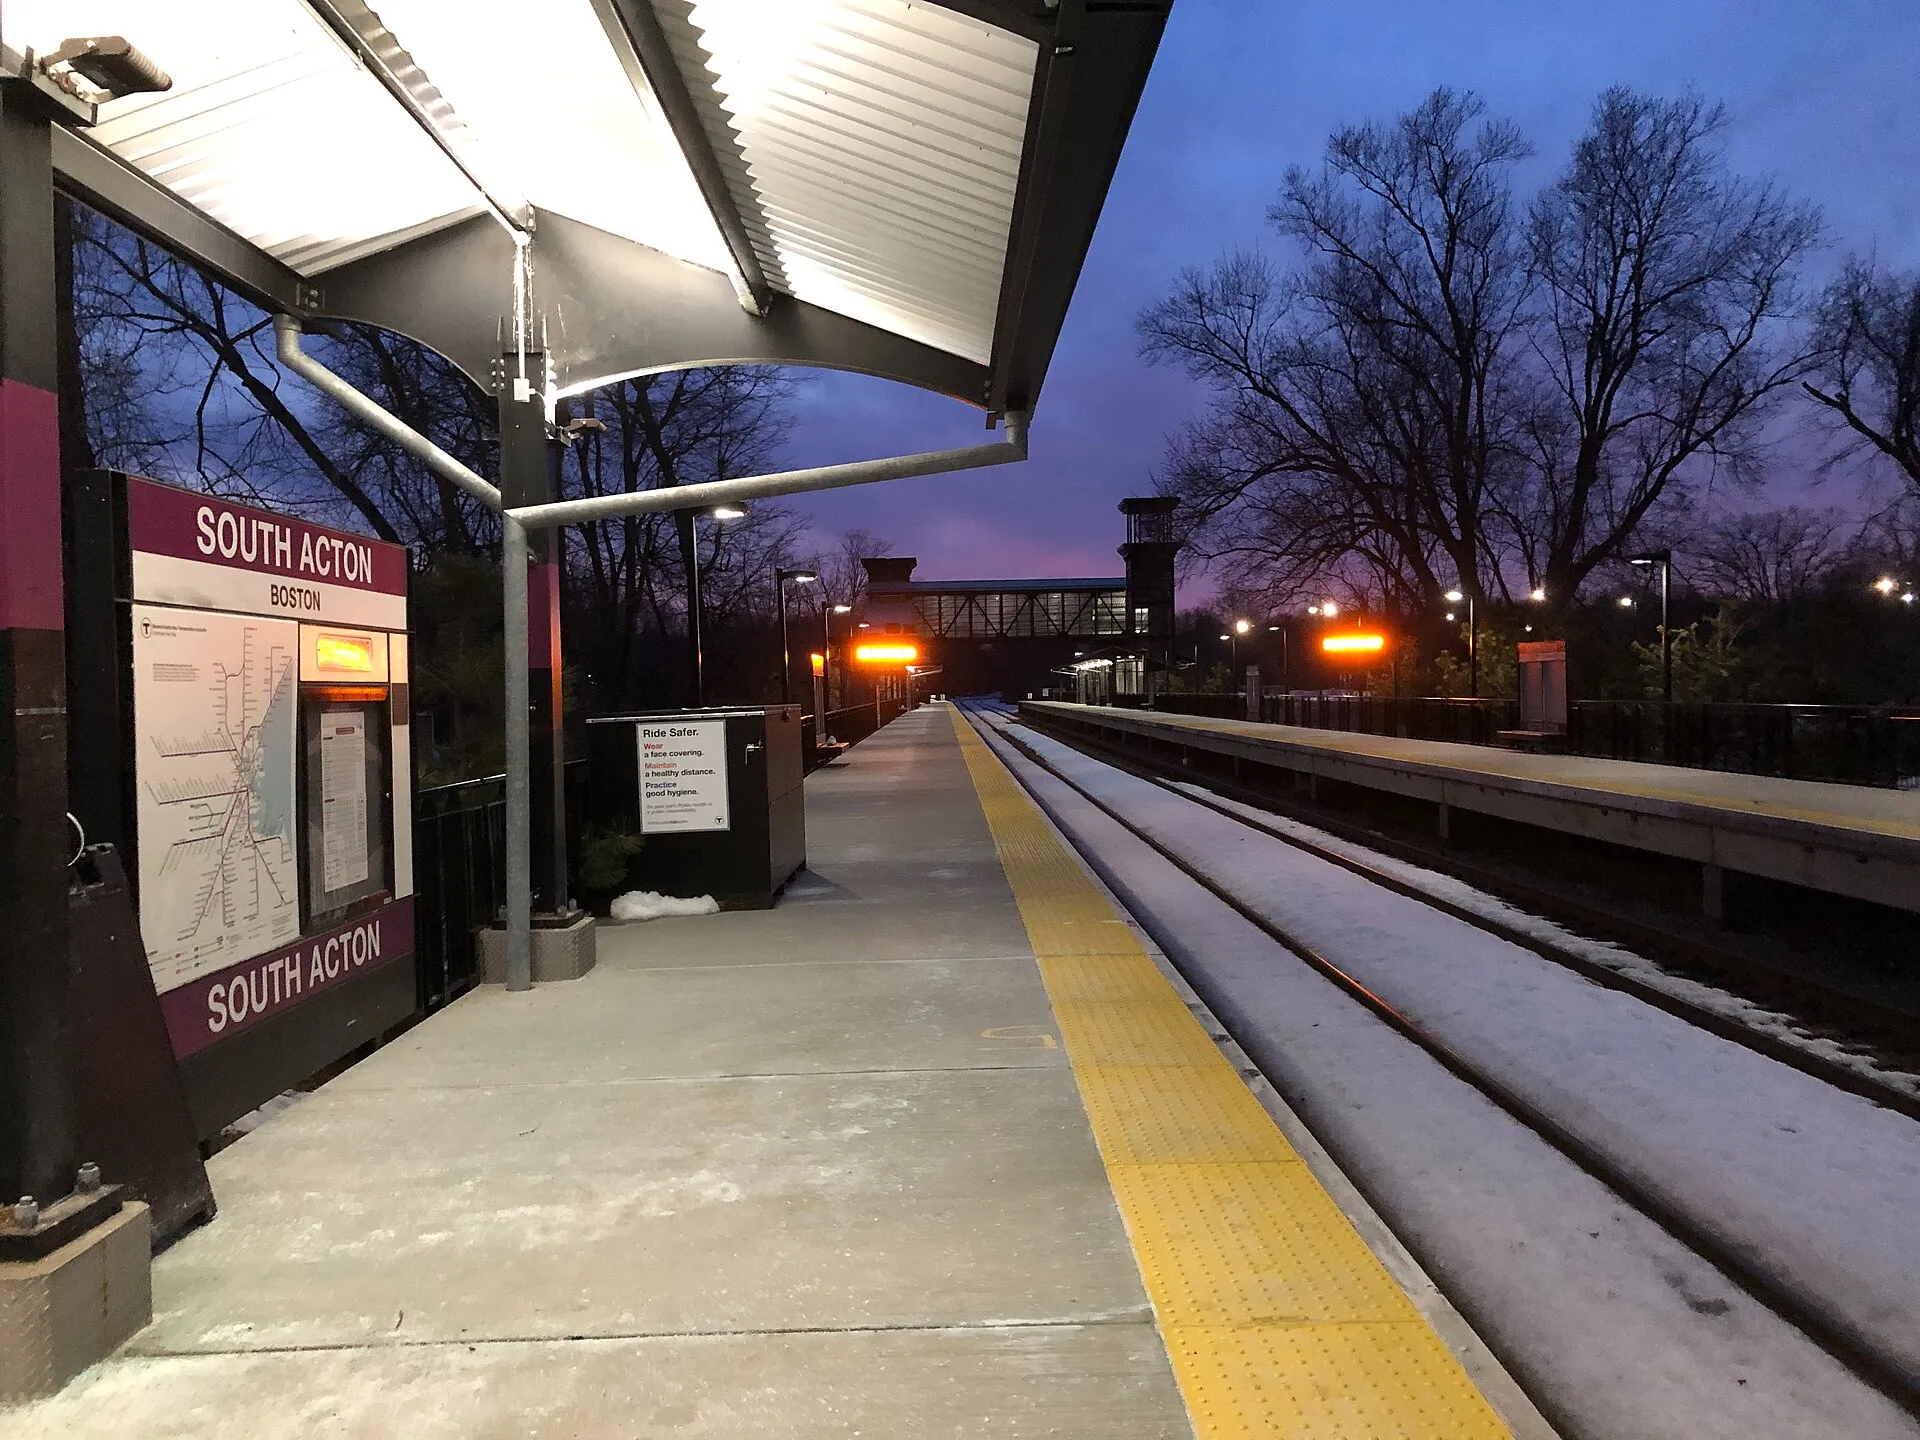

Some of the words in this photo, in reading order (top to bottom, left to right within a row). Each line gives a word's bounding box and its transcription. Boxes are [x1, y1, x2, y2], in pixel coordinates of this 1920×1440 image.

[197, 506, 292, 569] SOUTH
[300, 532, 372, 584] ACTON
[271, 584, 321, 612] BOSTON
[643, 729, 667, 738] Ride
[669, 727, 699, 737] Safer.
[669, 749, 704, 758] covering.
[651, 770, 680, 778] healthy
[681, 768, 716, 776] distance.
[645, 790, 666, 799] good
[667, 788, 700, 797] hygiene.
[207, 952, 302, 1033] SOUTH
[309, 920, 381, 988] ACTON
